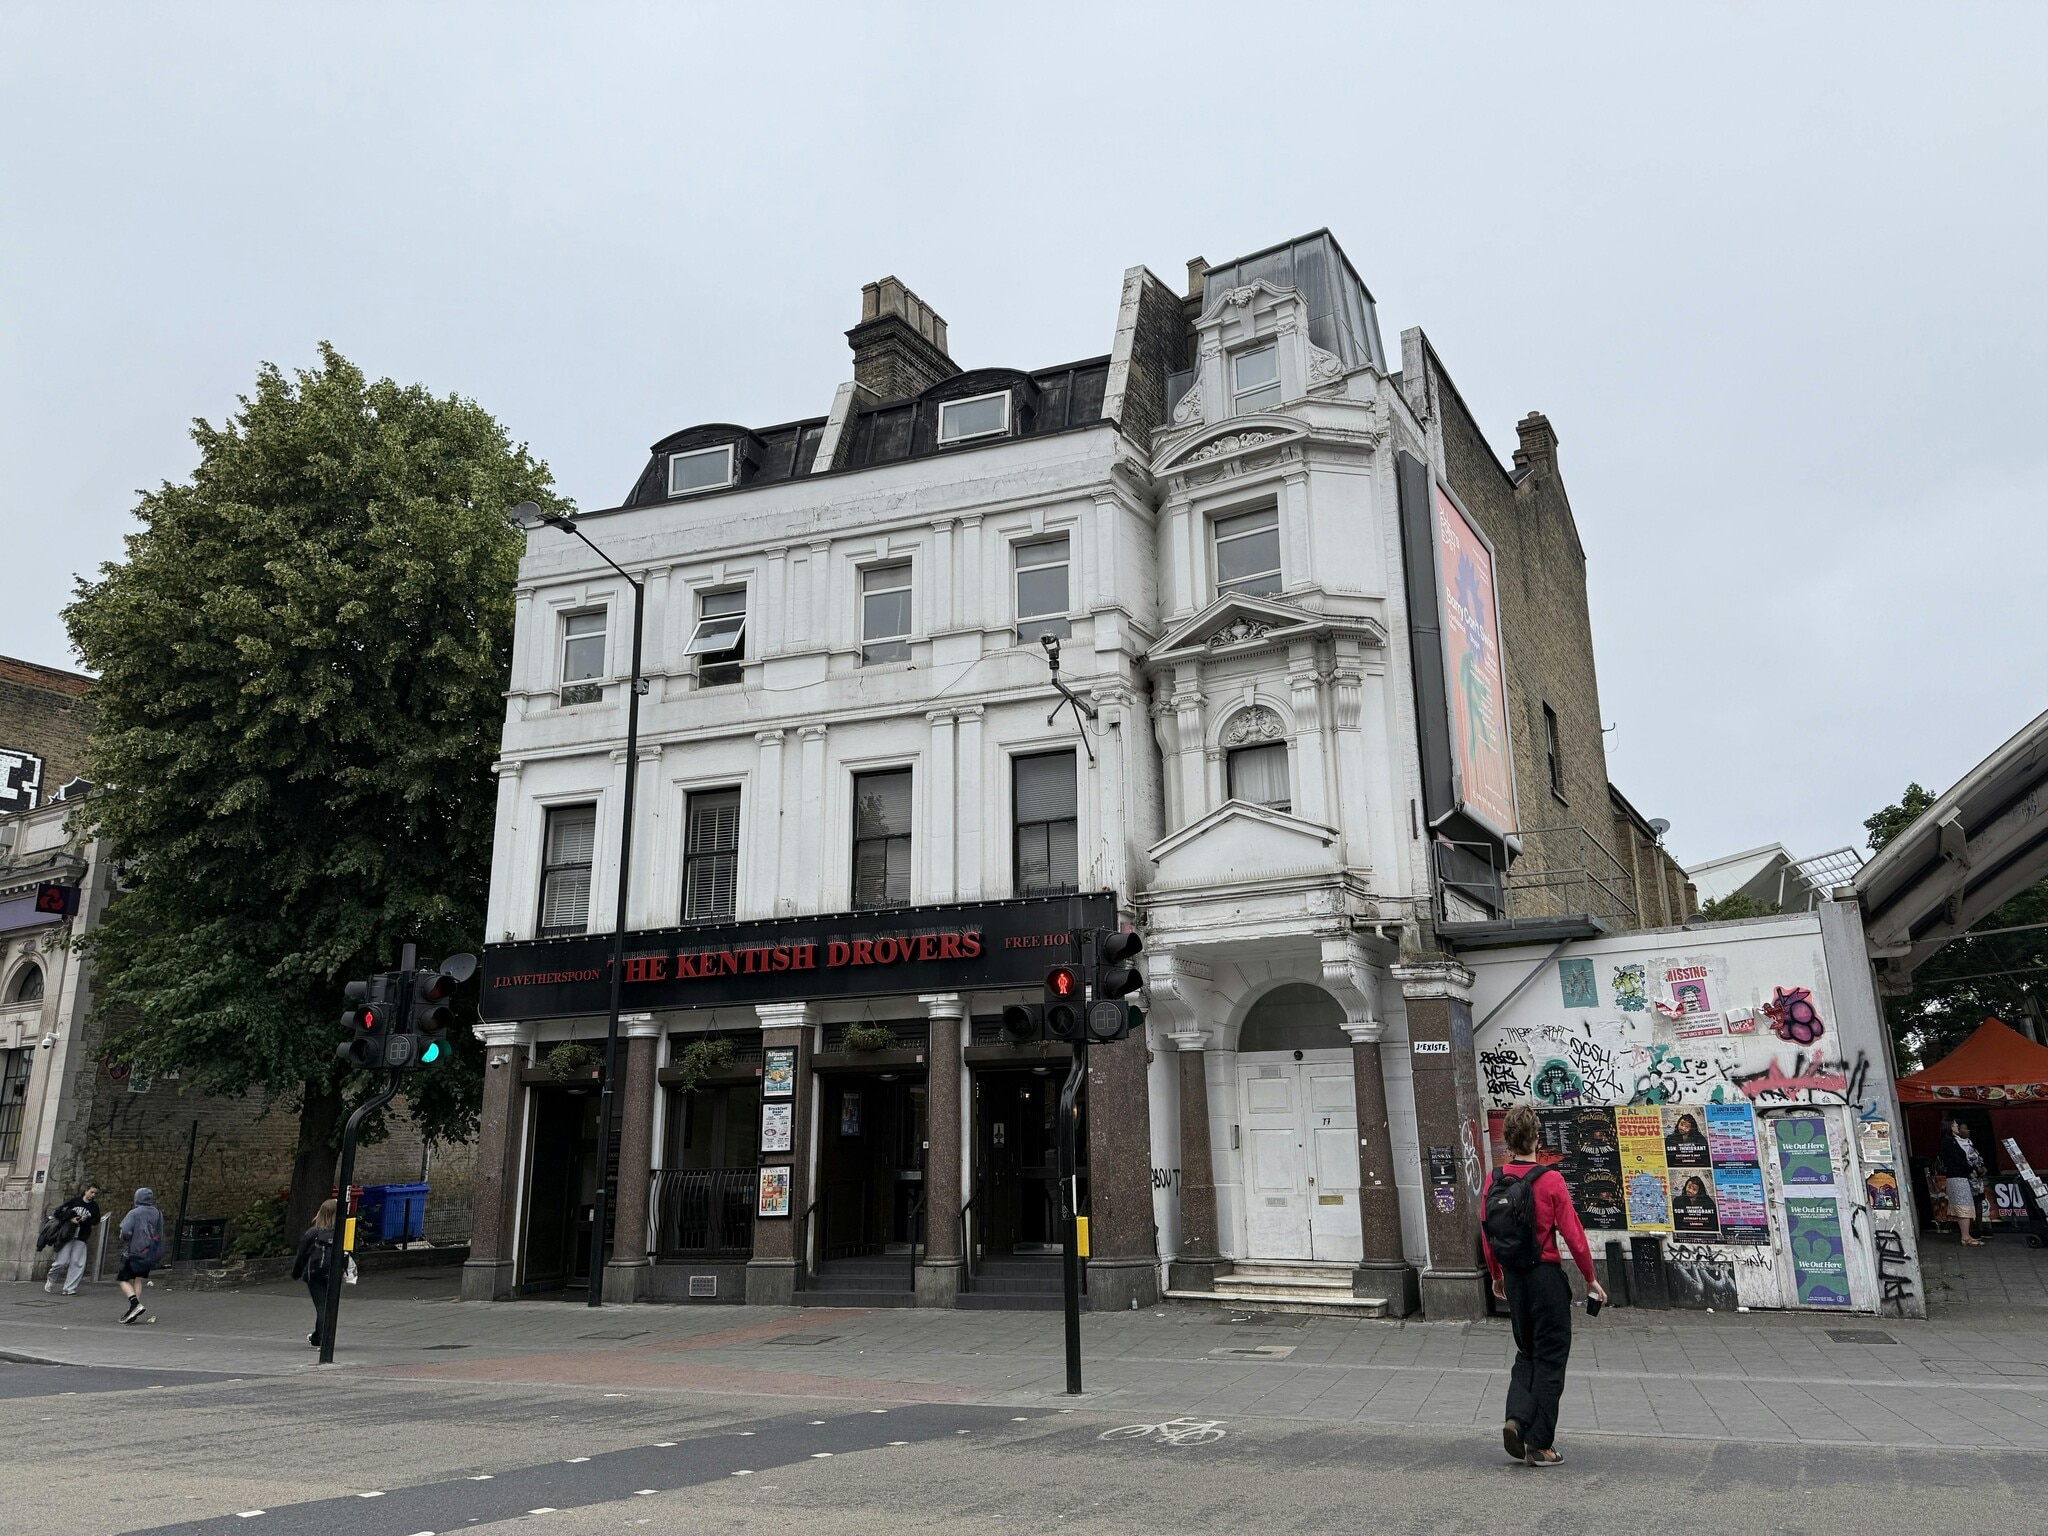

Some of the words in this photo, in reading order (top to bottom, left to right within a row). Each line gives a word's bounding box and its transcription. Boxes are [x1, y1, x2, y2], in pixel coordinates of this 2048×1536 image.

[1446, 586, 1464, 621] Barry
[1464, 606, 1481, 637] Can't
[1480, 624, 1496, 655] Swim
[1004, 935, 1041, 949] FREE
[1042, 932, 1070, 948] HOU
[675, 945, 816, 979] KENTISH
[826, 931, 982, 968] DROVERS
[494, 976, 512, 988] J.D.
[513, 969, 600, 986] WETHERSPOON
[1665, 966, 1707, 982] MISSING
[1415, 1043, 1449, 1052] J'EXISTE.
[1617, 1116, 1660, 1125] SUMMER
[1619, 1124, 1661, 1137] SHOW
[1151, 1168, 1181, 1197] ABOUT
[1825, 1261, 1842, 1269] Here
